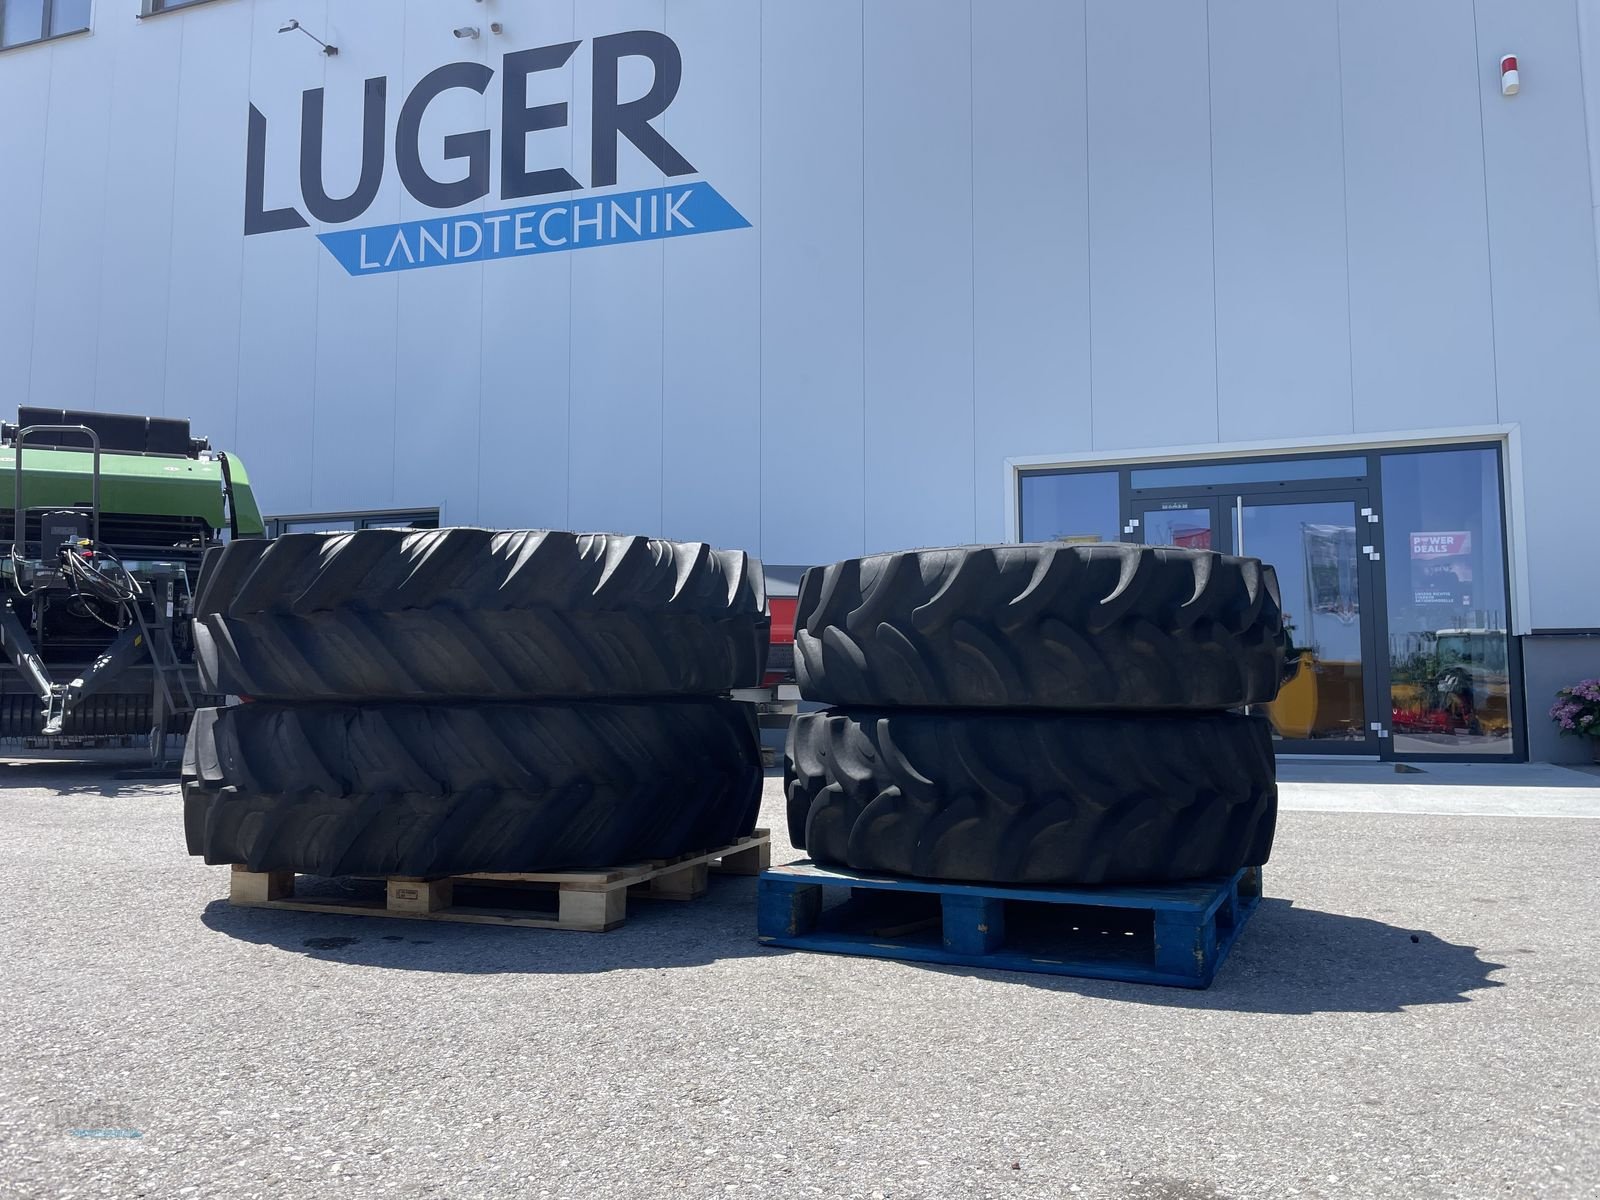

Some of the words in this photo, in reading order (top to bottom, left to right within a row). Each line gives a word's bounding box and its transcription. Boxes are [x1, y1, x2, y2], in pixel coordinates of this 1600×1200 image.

[244, 30, 699, 236] LUGER
[359, 189, 697, 270] LANDTECHNIK
[1414, 545, 1448, 553] DEALS
